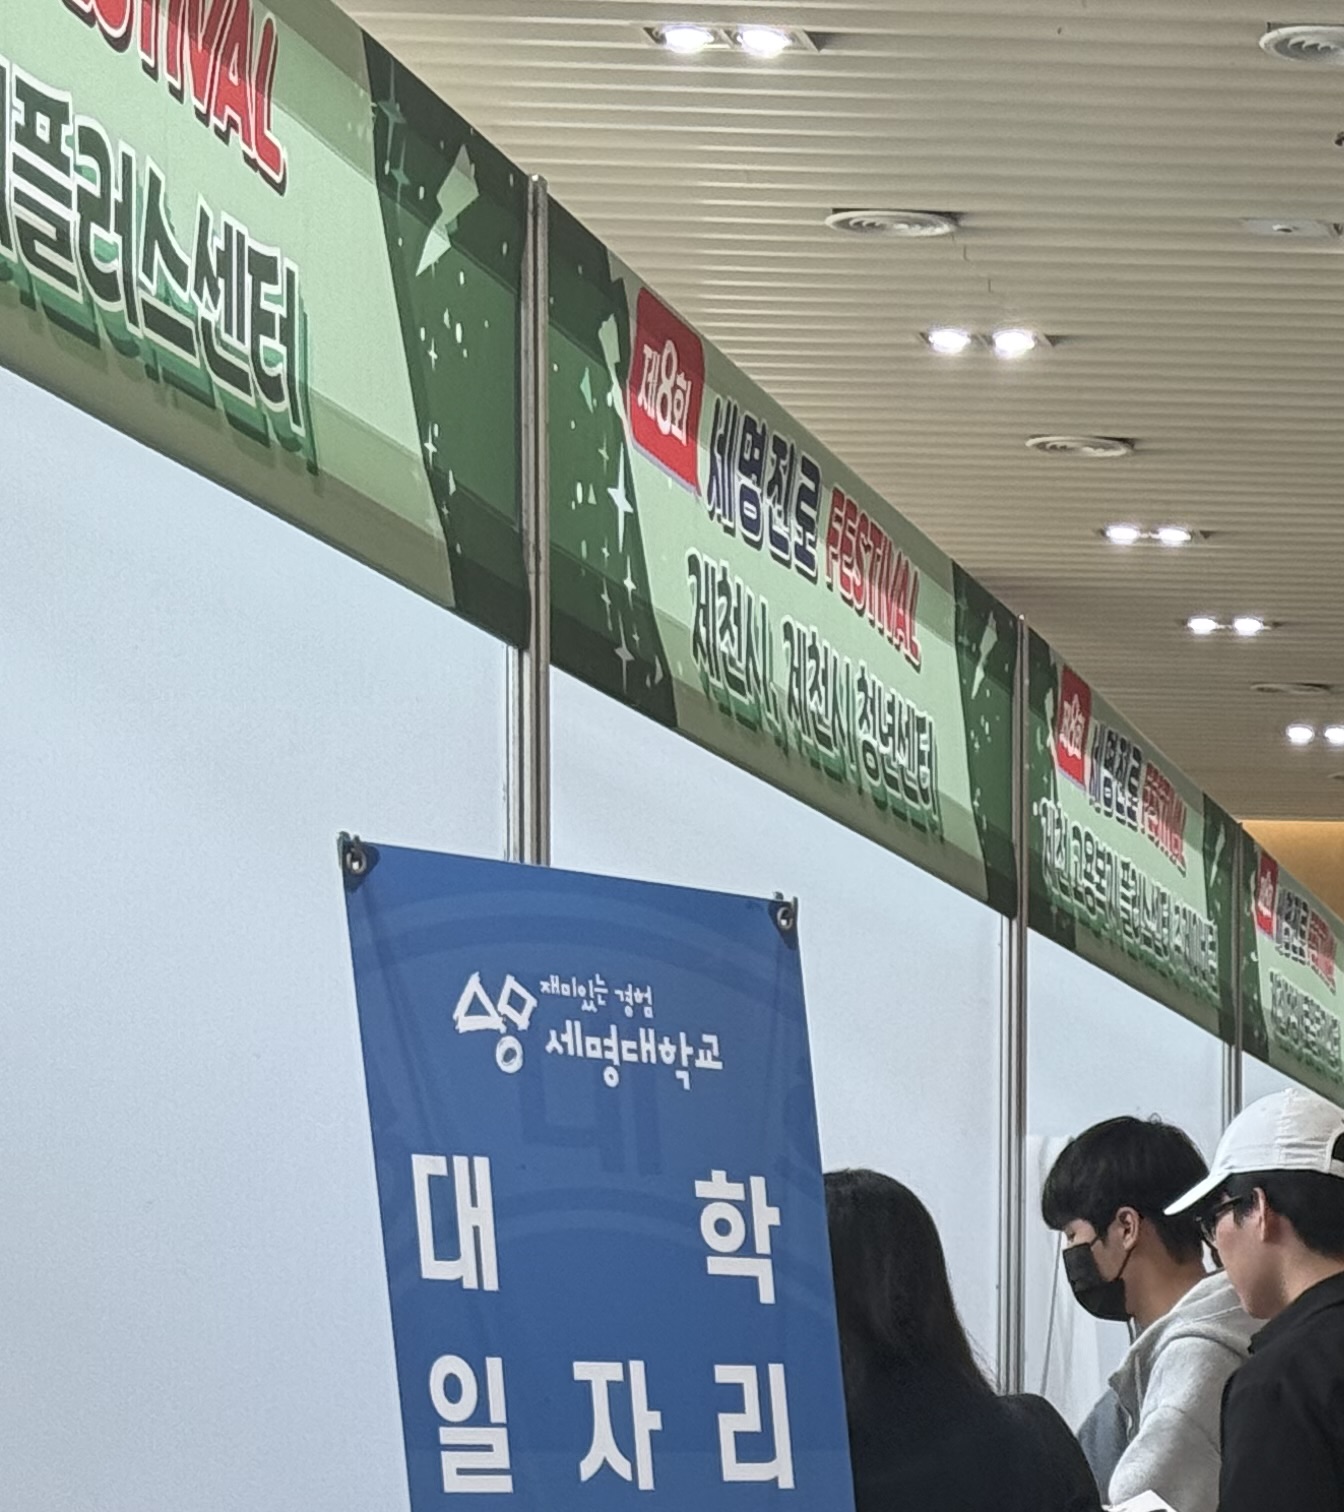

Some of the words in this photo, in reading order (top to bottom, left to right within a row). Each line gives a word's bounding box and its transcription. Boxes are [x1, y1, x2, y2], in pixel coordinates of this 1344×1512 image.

[707, 397, 821, 580] 세명진로
[826, 486, 923, 668] FESTIVAL
[544, 1018, 724, 1091] 세명대학교
